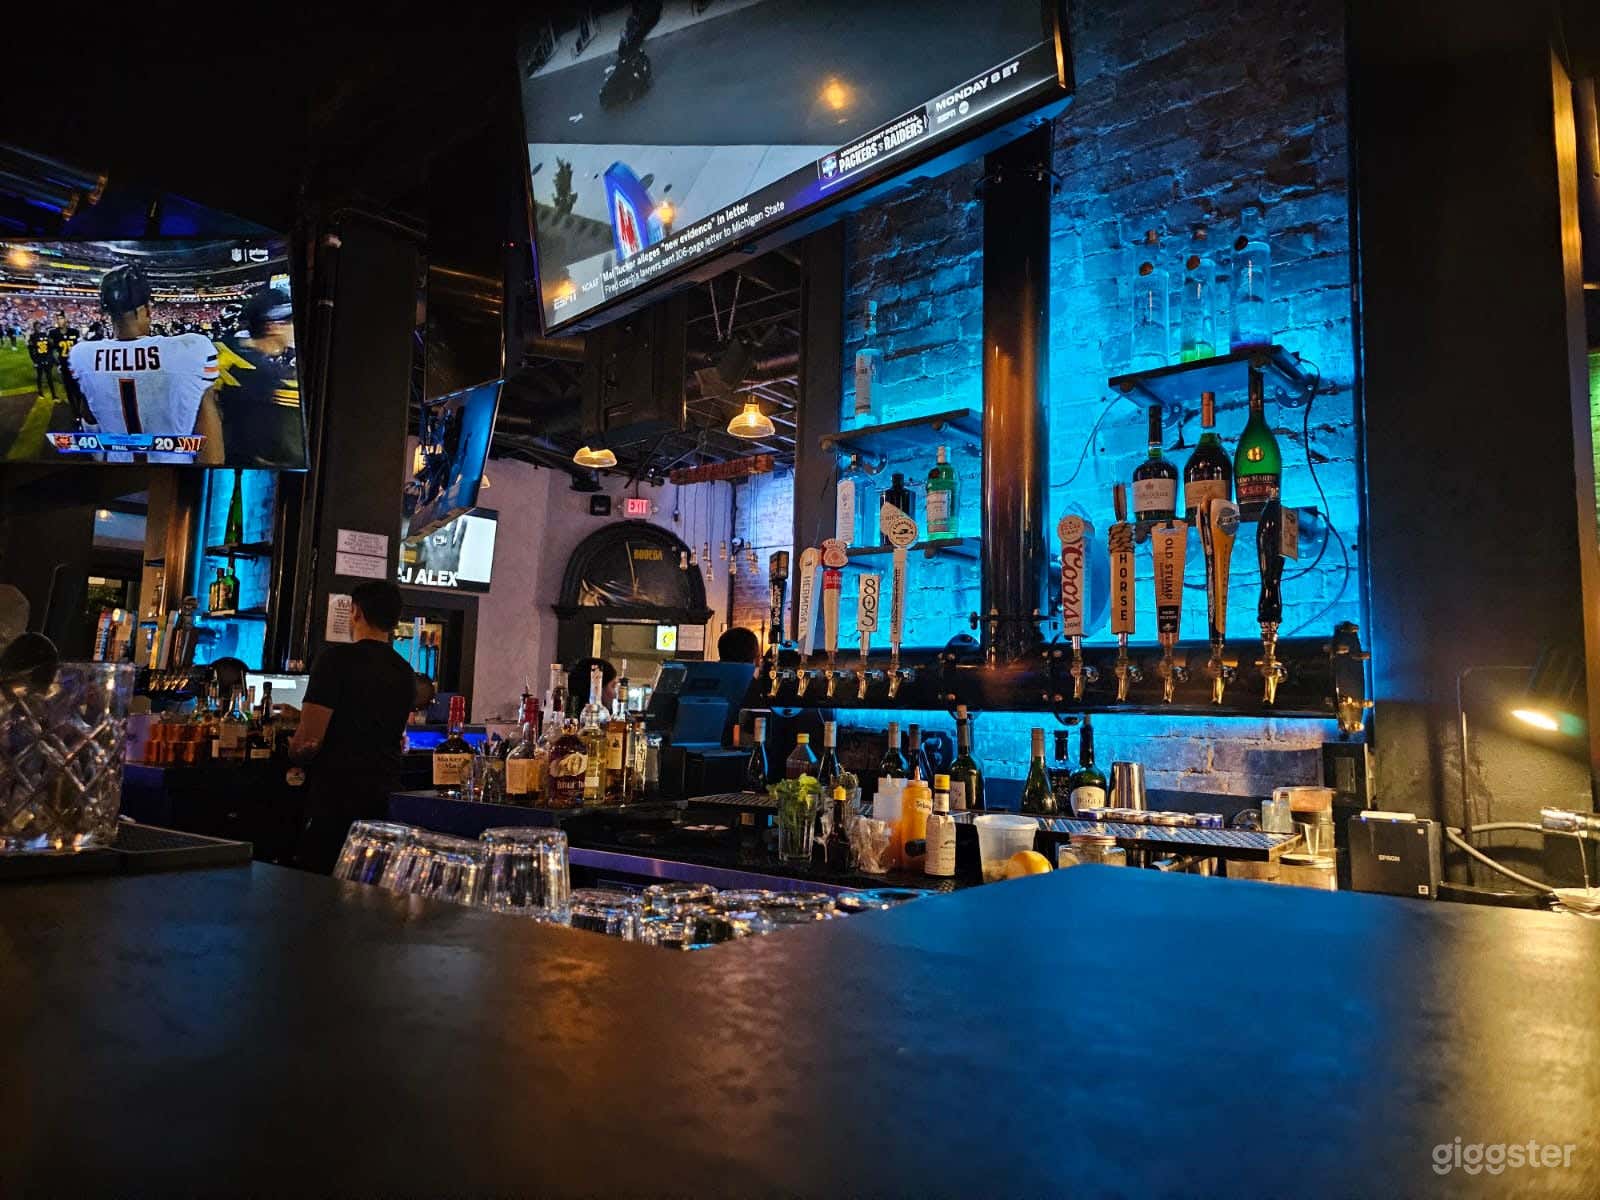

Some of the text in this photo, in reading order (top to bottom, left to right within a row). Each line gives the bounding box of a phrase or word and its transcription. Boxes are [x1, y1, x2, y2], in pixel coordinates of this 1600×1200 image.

[935, 77, 989, 112] MONDAY
[1002, 61, 1020, 79] ET
[839, 142, 878, 173] PACKERS
[883, 118, 924, 151] RAIDERS
[885, 114, 919, 134] FOOTBALL
[614, 260, 636, 275] Tucker
[636, 247, 661, 265] alleges
[716, 213, 725, 225] in
[726, 202, 749, 221] letter
[639, 261, 662, 278] lawyers
[662, 254, 675, 270] sent
[704, 230, 723, 246] letter
[723, 226, 731, 238] to
[731, 211, 764, 233] Michigan
[764, 200, 785, 218] State
[95, 345, 161, 371] FIELDS
[118, 378, 145, 435] 1
[78, 436, 98, 449] 40
[155, 438, 174, 450] 20
[627, 498, 648, 513] EXIT
[1164, 537, 1173, 559] OLD
[414, 568, 458, 588] ALEX
[801, 575, 811, 627] HERMOSA
[861, 578, 876, 627] 805
[1062, 543, 1083, 622] Coors
[1119, 553, 1128, 621] HORSE
[1164, 562, 1173, 600] STUMP
